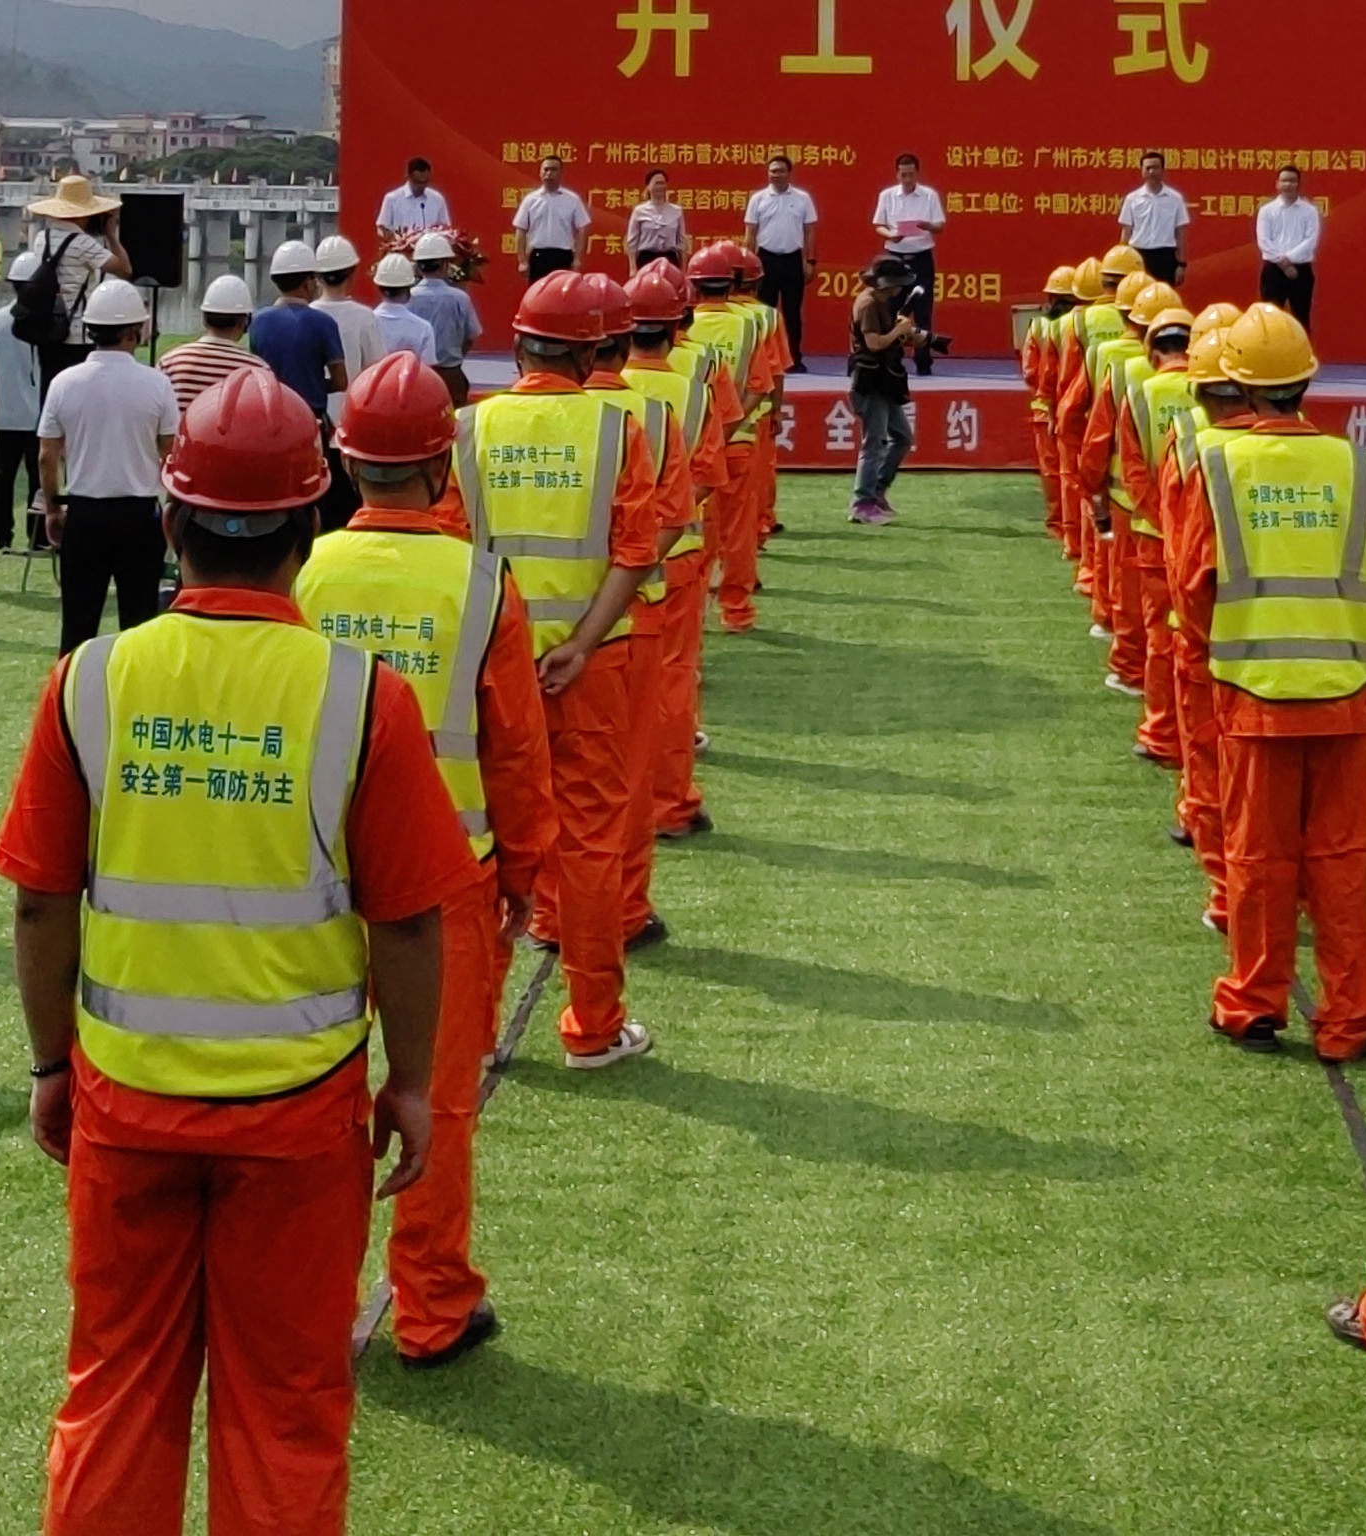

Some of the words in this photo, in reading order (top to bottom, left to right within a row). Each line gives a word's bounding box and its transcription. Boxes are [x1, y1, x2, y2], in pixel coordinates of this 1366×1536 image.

[488, 444, 577, 464] 中国水电十一局
[1247, 484, 1335, 504] 中国水电十一局
[320, 612, 435, 643] 中国水电十一局
[131, 714, 283, 759] 中国水电十一局
[120, 761, 295, 805] 安全第一预防为主
